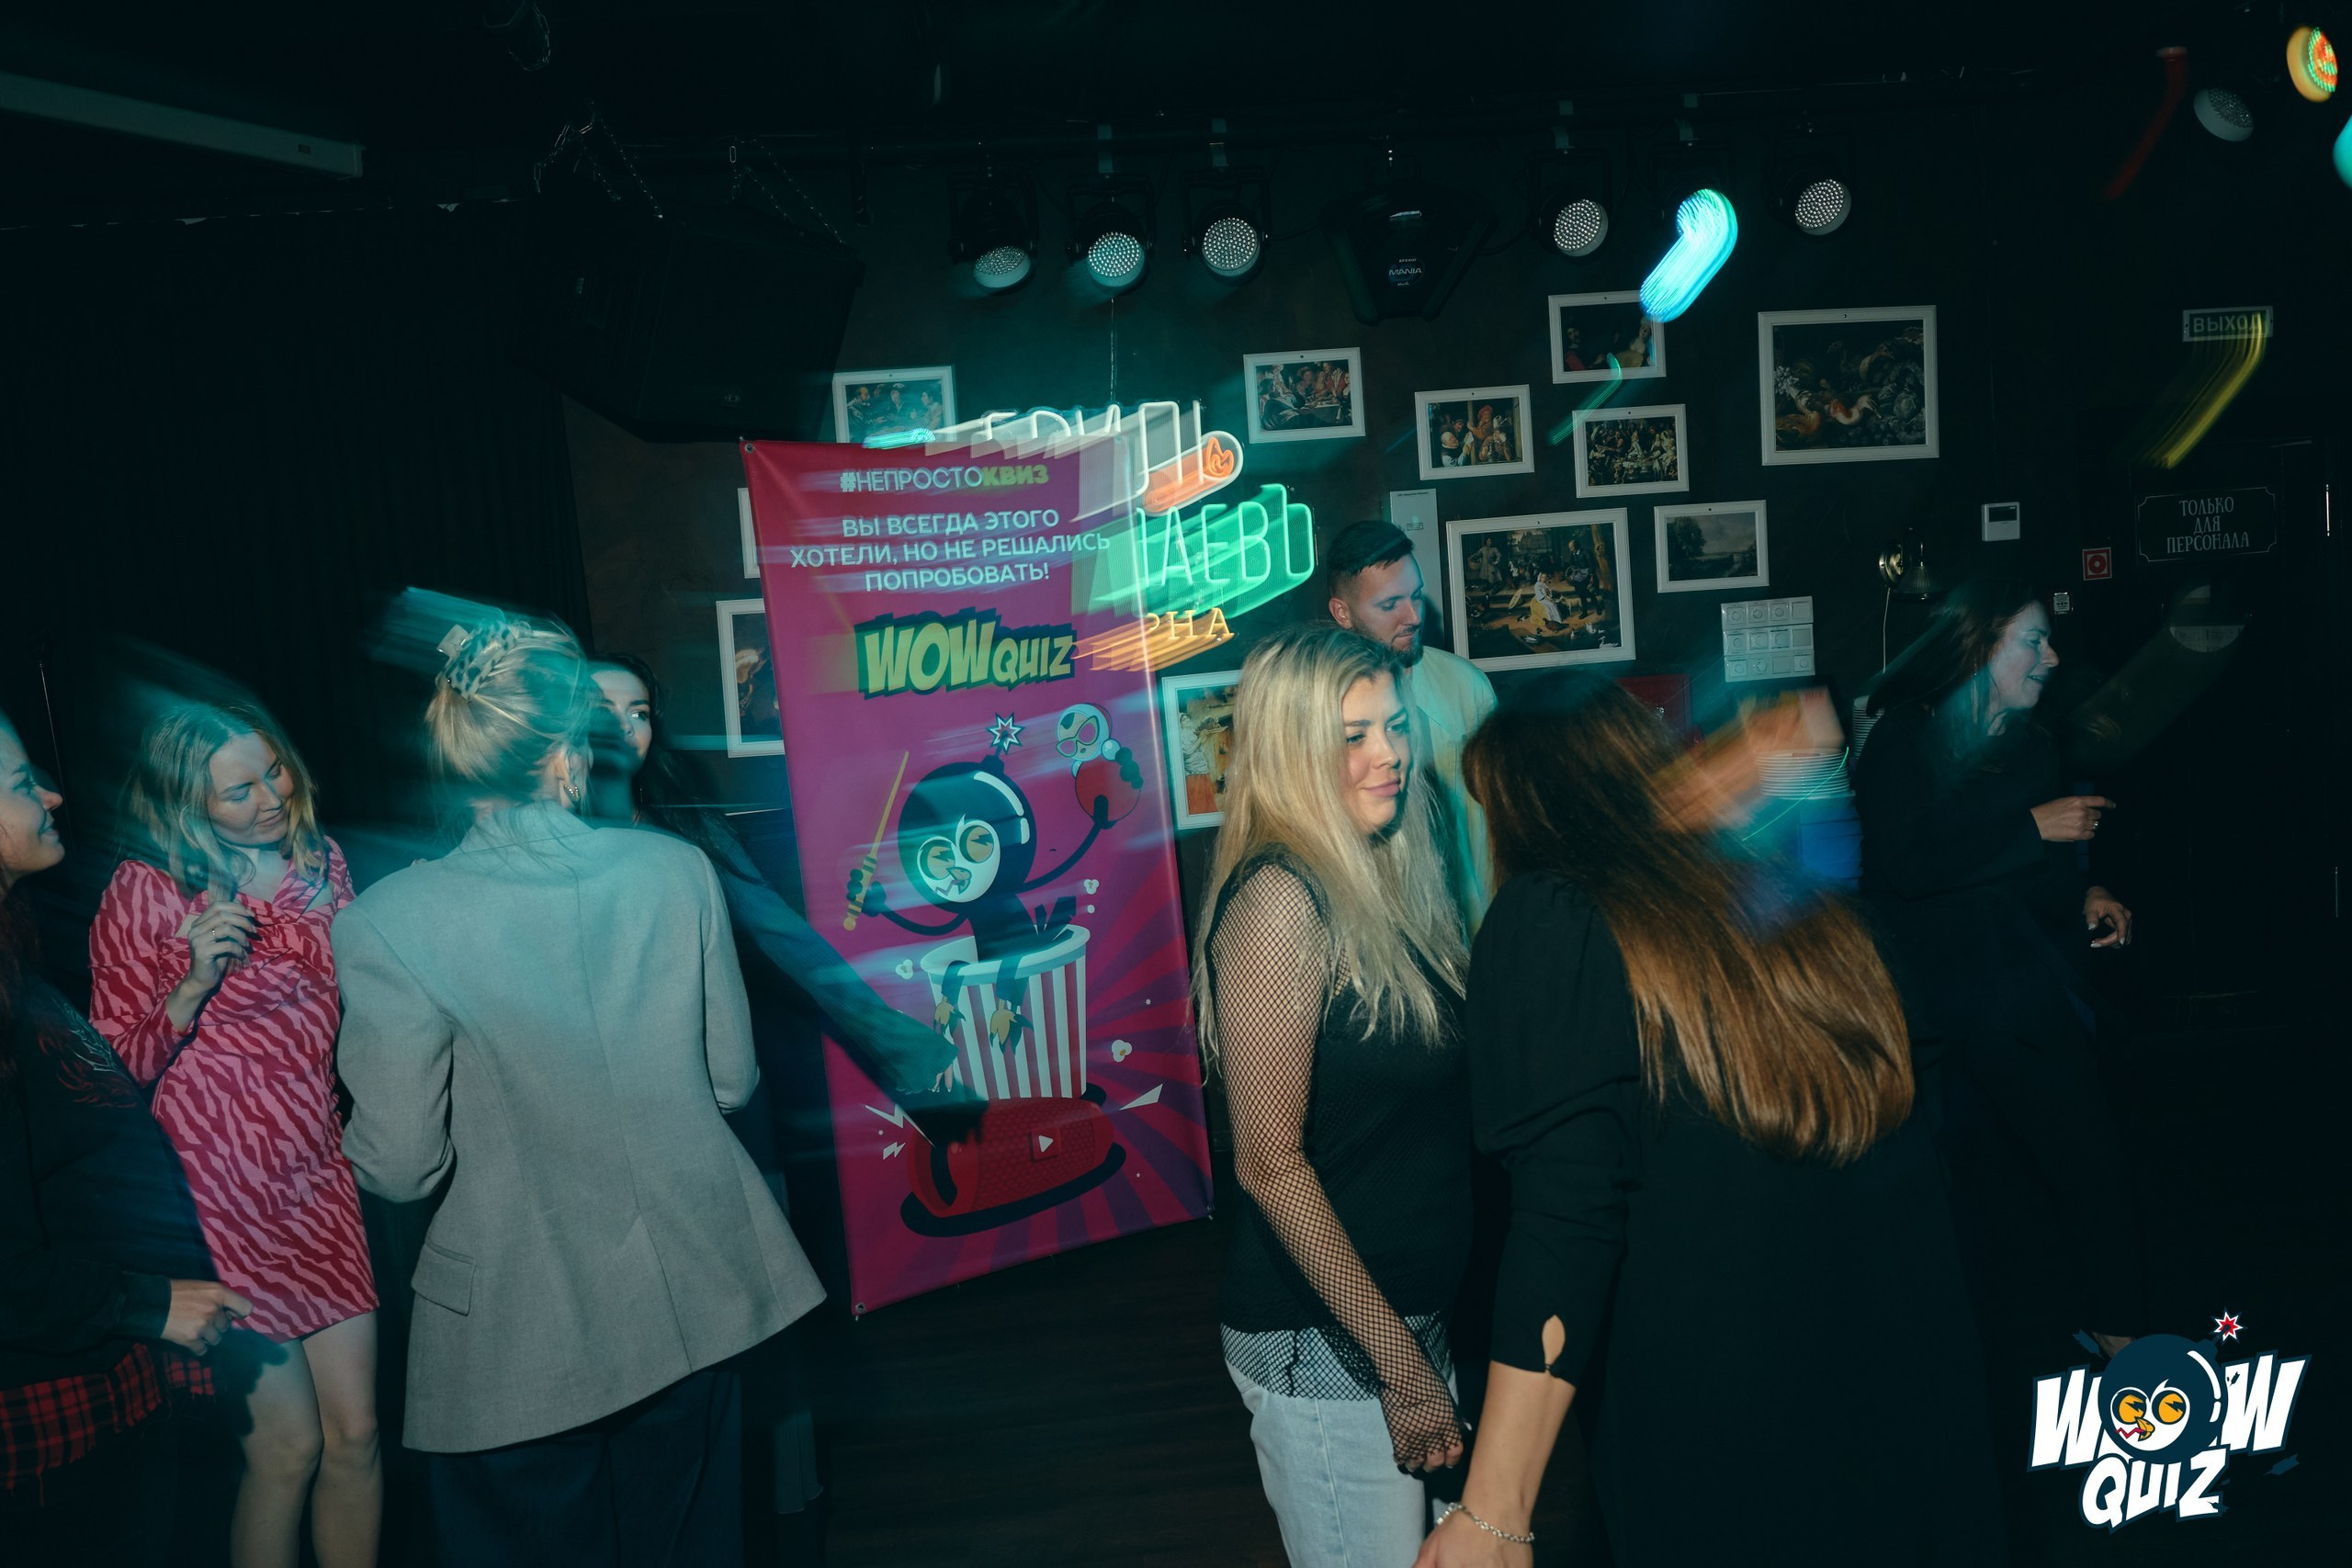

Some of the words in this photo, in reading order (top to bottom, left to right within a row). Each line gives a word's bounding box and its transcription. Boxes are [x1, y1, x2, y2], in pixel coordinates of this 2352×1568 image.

[1388, 267, 1422, 276] MANIA
[2193, 313, 2263, 333] ВЫХОД
[2178, 496, 2234, 516] ТОЛЬКО
[842, 517, 879, 537] ВЫ
[888, 512, 979, 535] ВСЕГДА
[984, 508, 1059, 531] ЭТОГО
[2193, 515, 2222, 536] ДЛЯ
[789, 545, 898, 569] ХОТЕЛИ,
[904, 542, 938, 562] НО
[945, 539, 977, 559] НЕ
[982, 533, 1111, 557] РЕШАЛИСЬ
[2166, 531, 2250, 554] ПЕРСОНАЛА
[865, 562, 1049, 592] ПОПРОБОВАТЬ!
